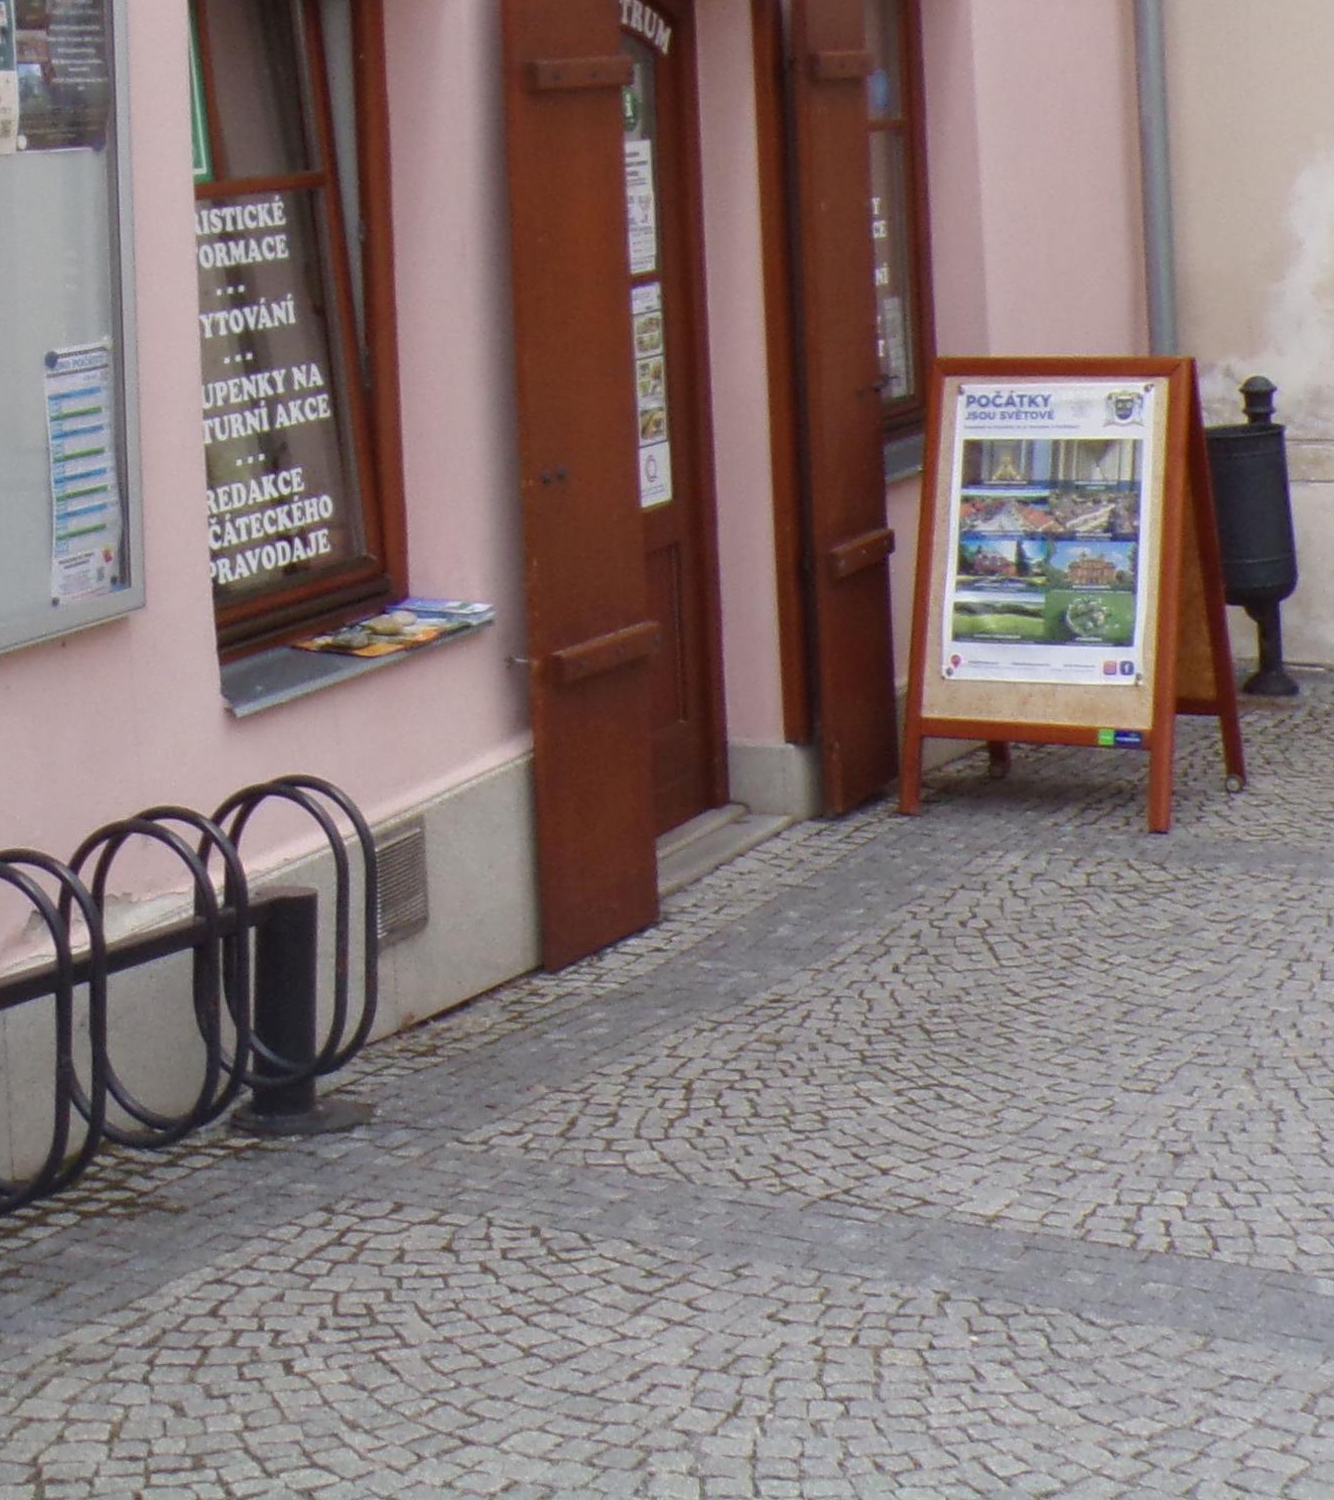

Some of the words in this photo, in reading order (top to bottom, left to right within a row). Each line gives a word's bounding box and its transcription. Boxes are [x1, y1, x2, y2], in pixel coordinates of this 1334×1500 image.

[198, 234, 289, 269] ORMACE
[291, 363, 324, 390] NA
[275, 394, 332, 429] AKCE
[965, 411, 996, 421] JSOU
[999, 409, 1055, 421] SVĚTOVÉ
[966, 389, 1052, 408] POČÁTKY
[206, 467, 305, 515] REDAKCE
[208, 495, 334, 550] ČÁTECKÉHO
